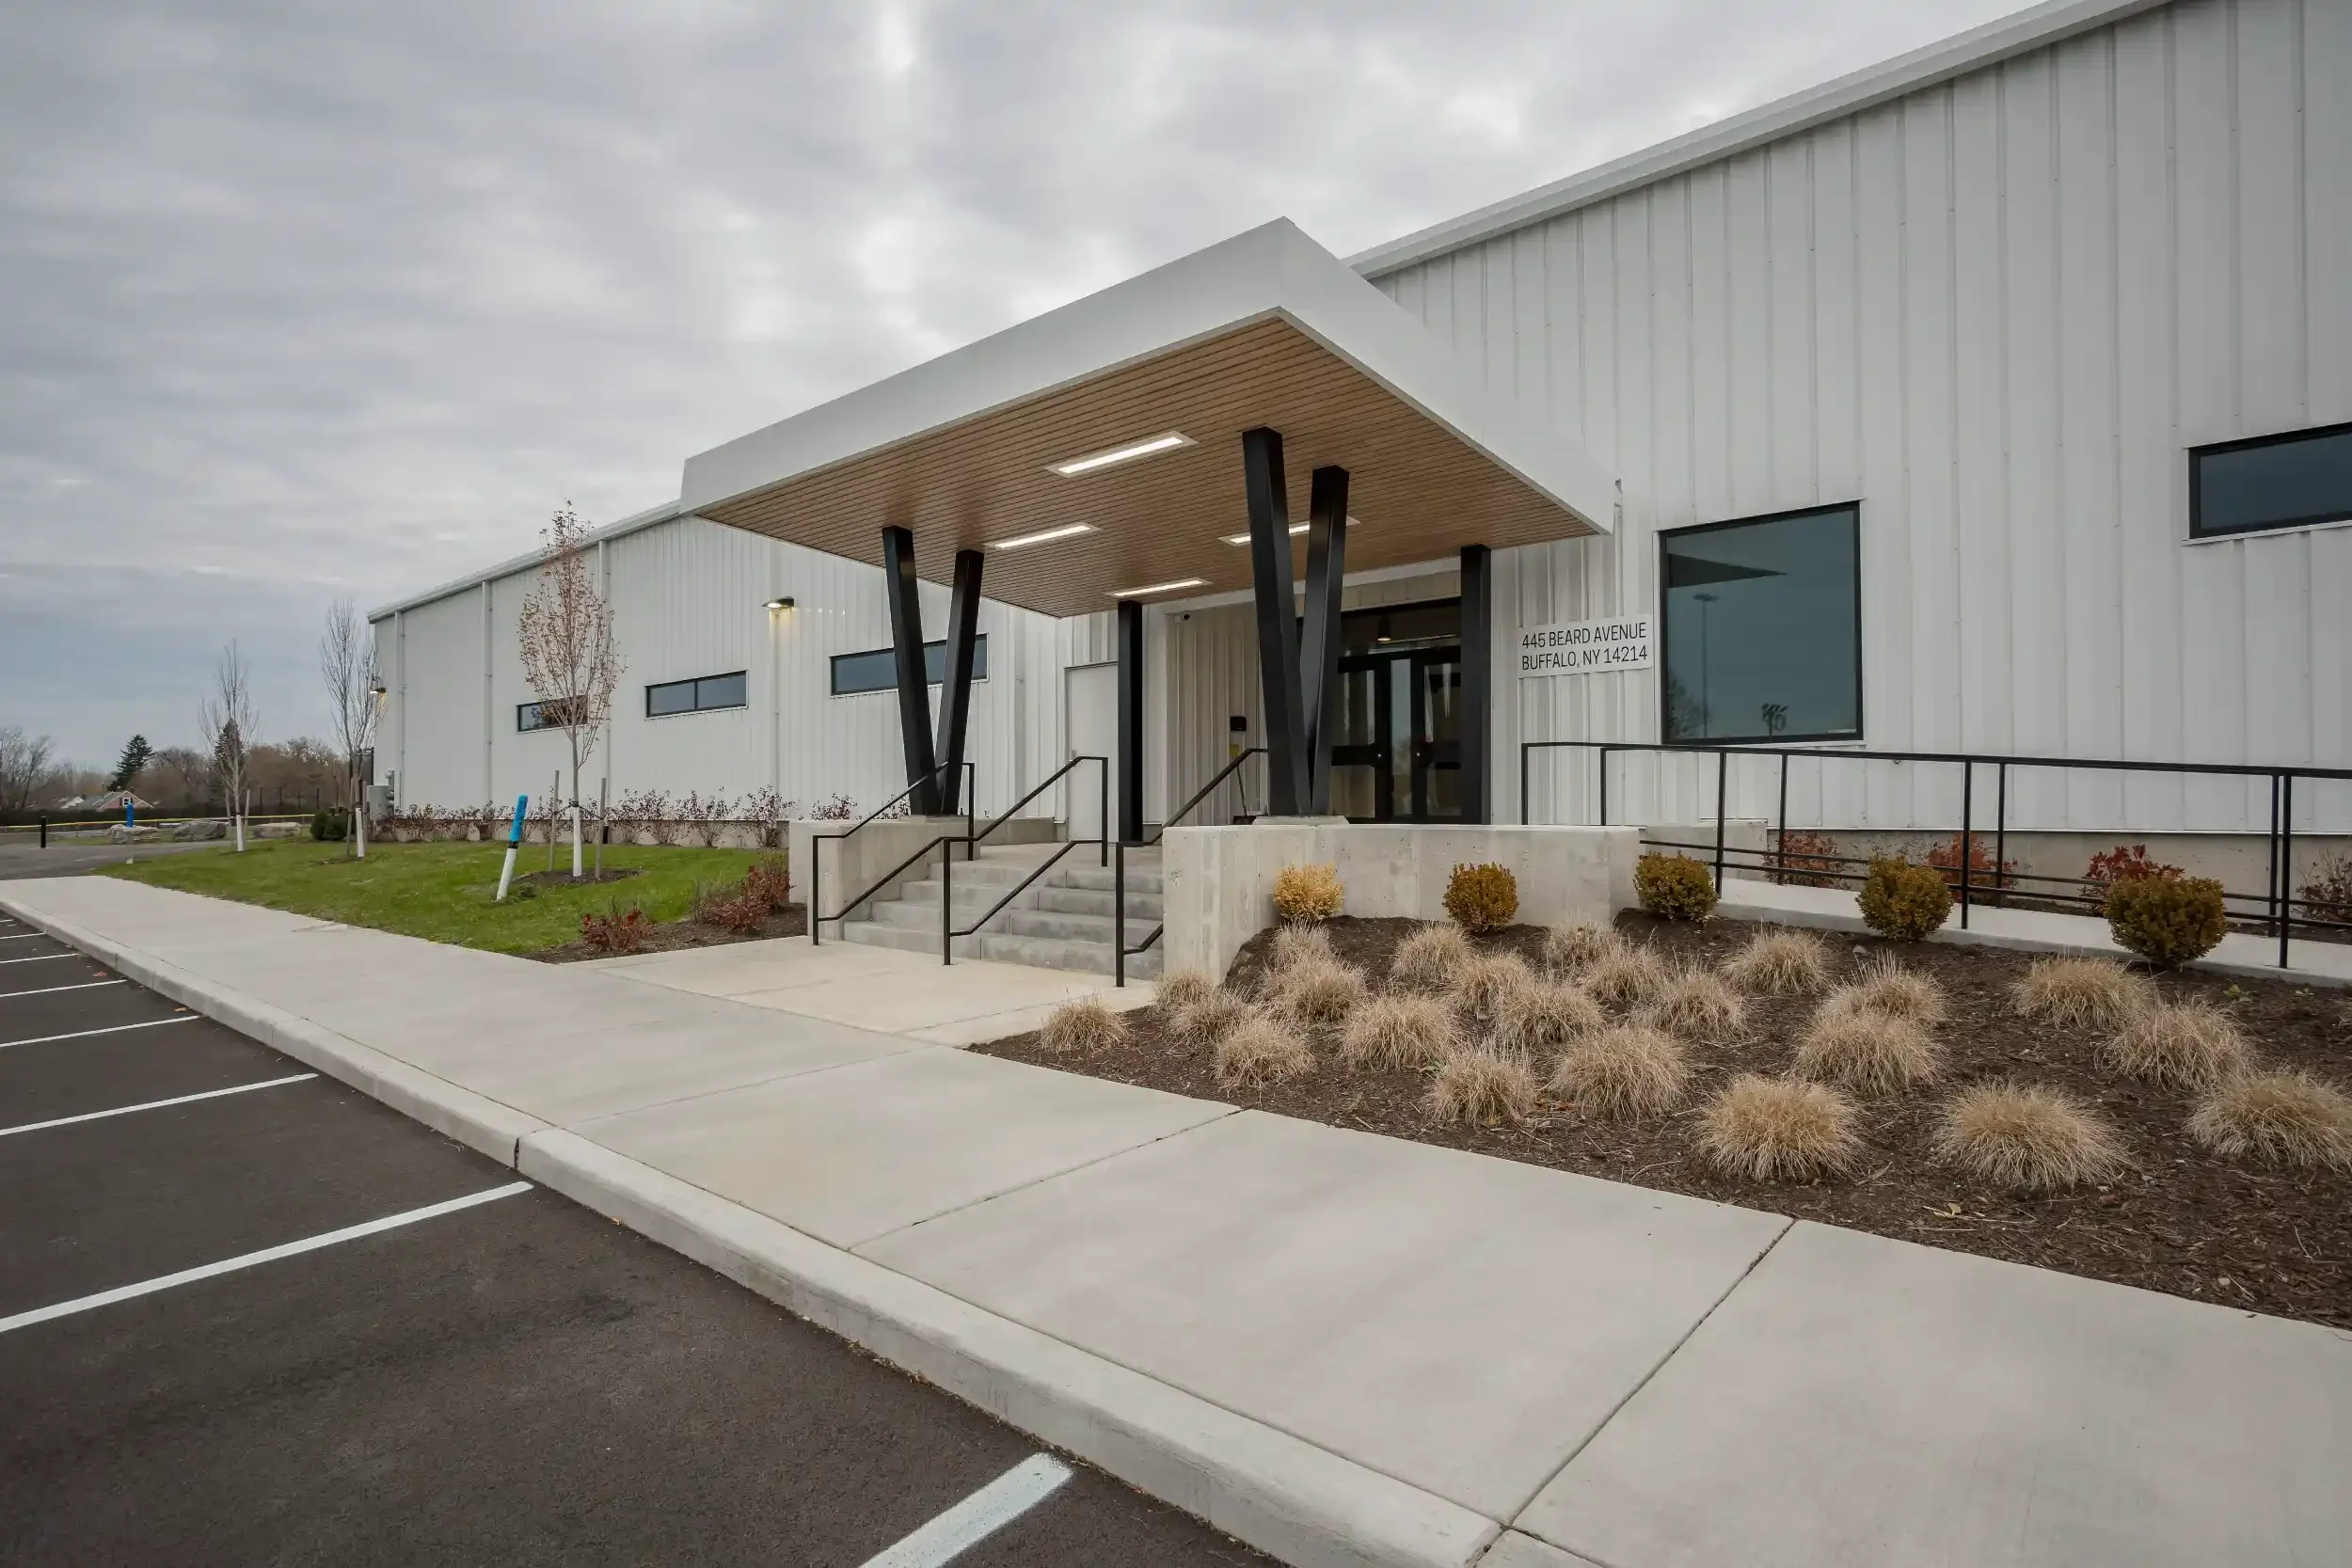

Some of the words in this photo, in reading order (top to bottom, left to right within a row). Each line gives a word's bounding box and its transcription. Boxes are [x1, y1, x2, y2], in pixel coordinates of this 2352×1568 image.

[1522, 633, 1546, 649] 445
[1549, 628, 1591, 647] BEARD
[1594, 622, 1646, 642] AVENUE
[1522, 651, 1580, 671] BUFFALO,
[1582, 648, 1601, 666] NY
[1603, 644, 1647, 664] 14214
